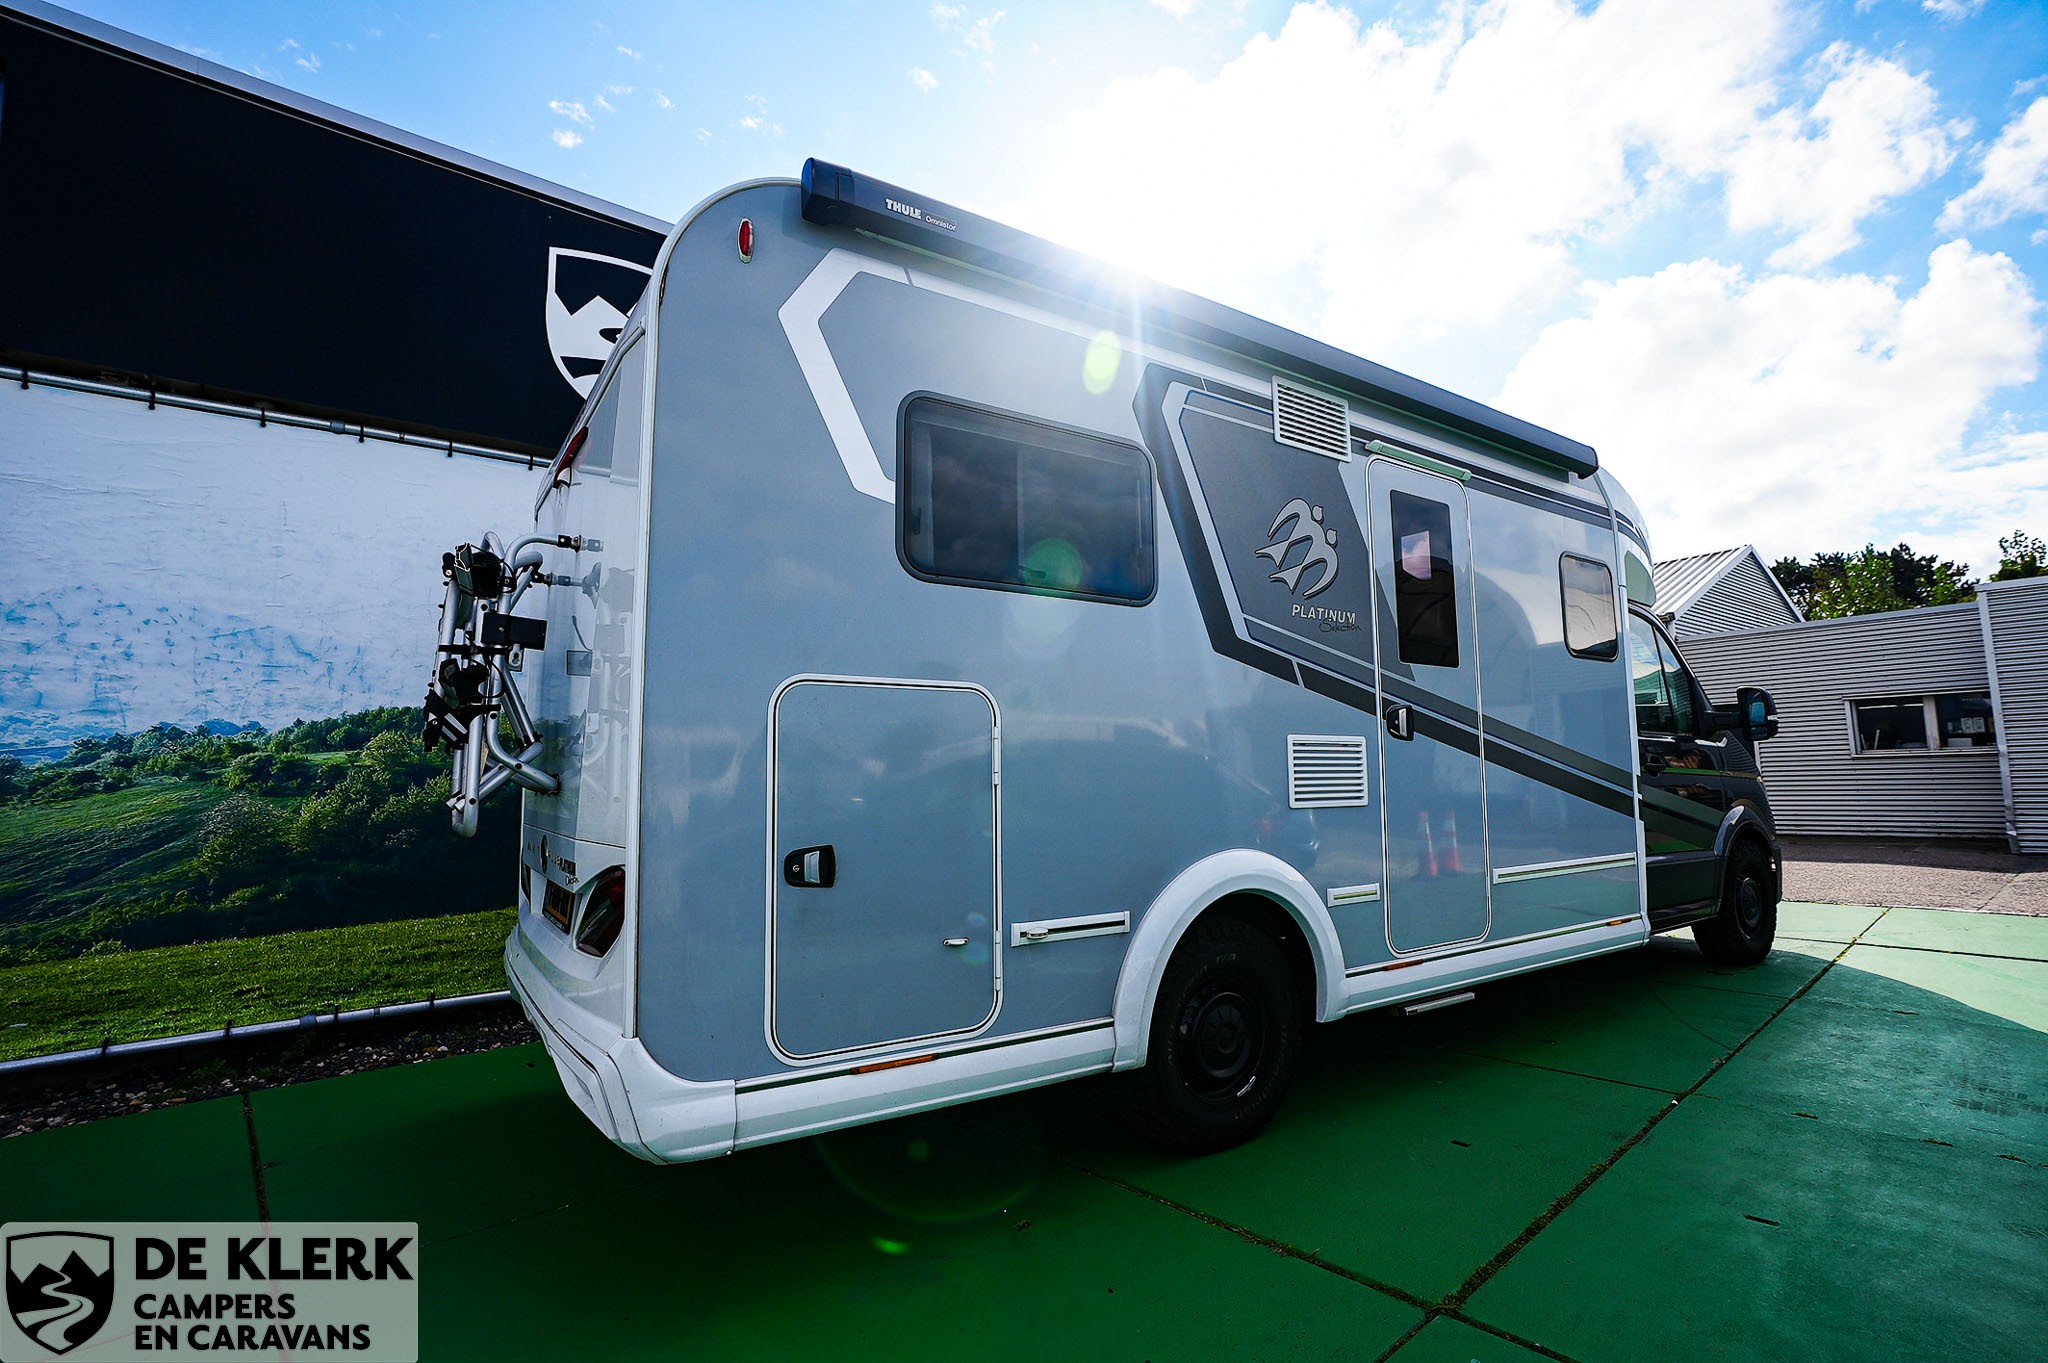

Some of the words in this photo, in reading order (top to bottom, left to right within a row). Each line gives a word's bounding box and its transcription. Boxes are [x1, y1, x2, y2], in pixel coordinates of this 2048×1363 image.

[885, 198, 922, 220] THULE
[925, 215, 957, 232] Omnistor
[1291, 604, 1356, 625] PLATINUM
